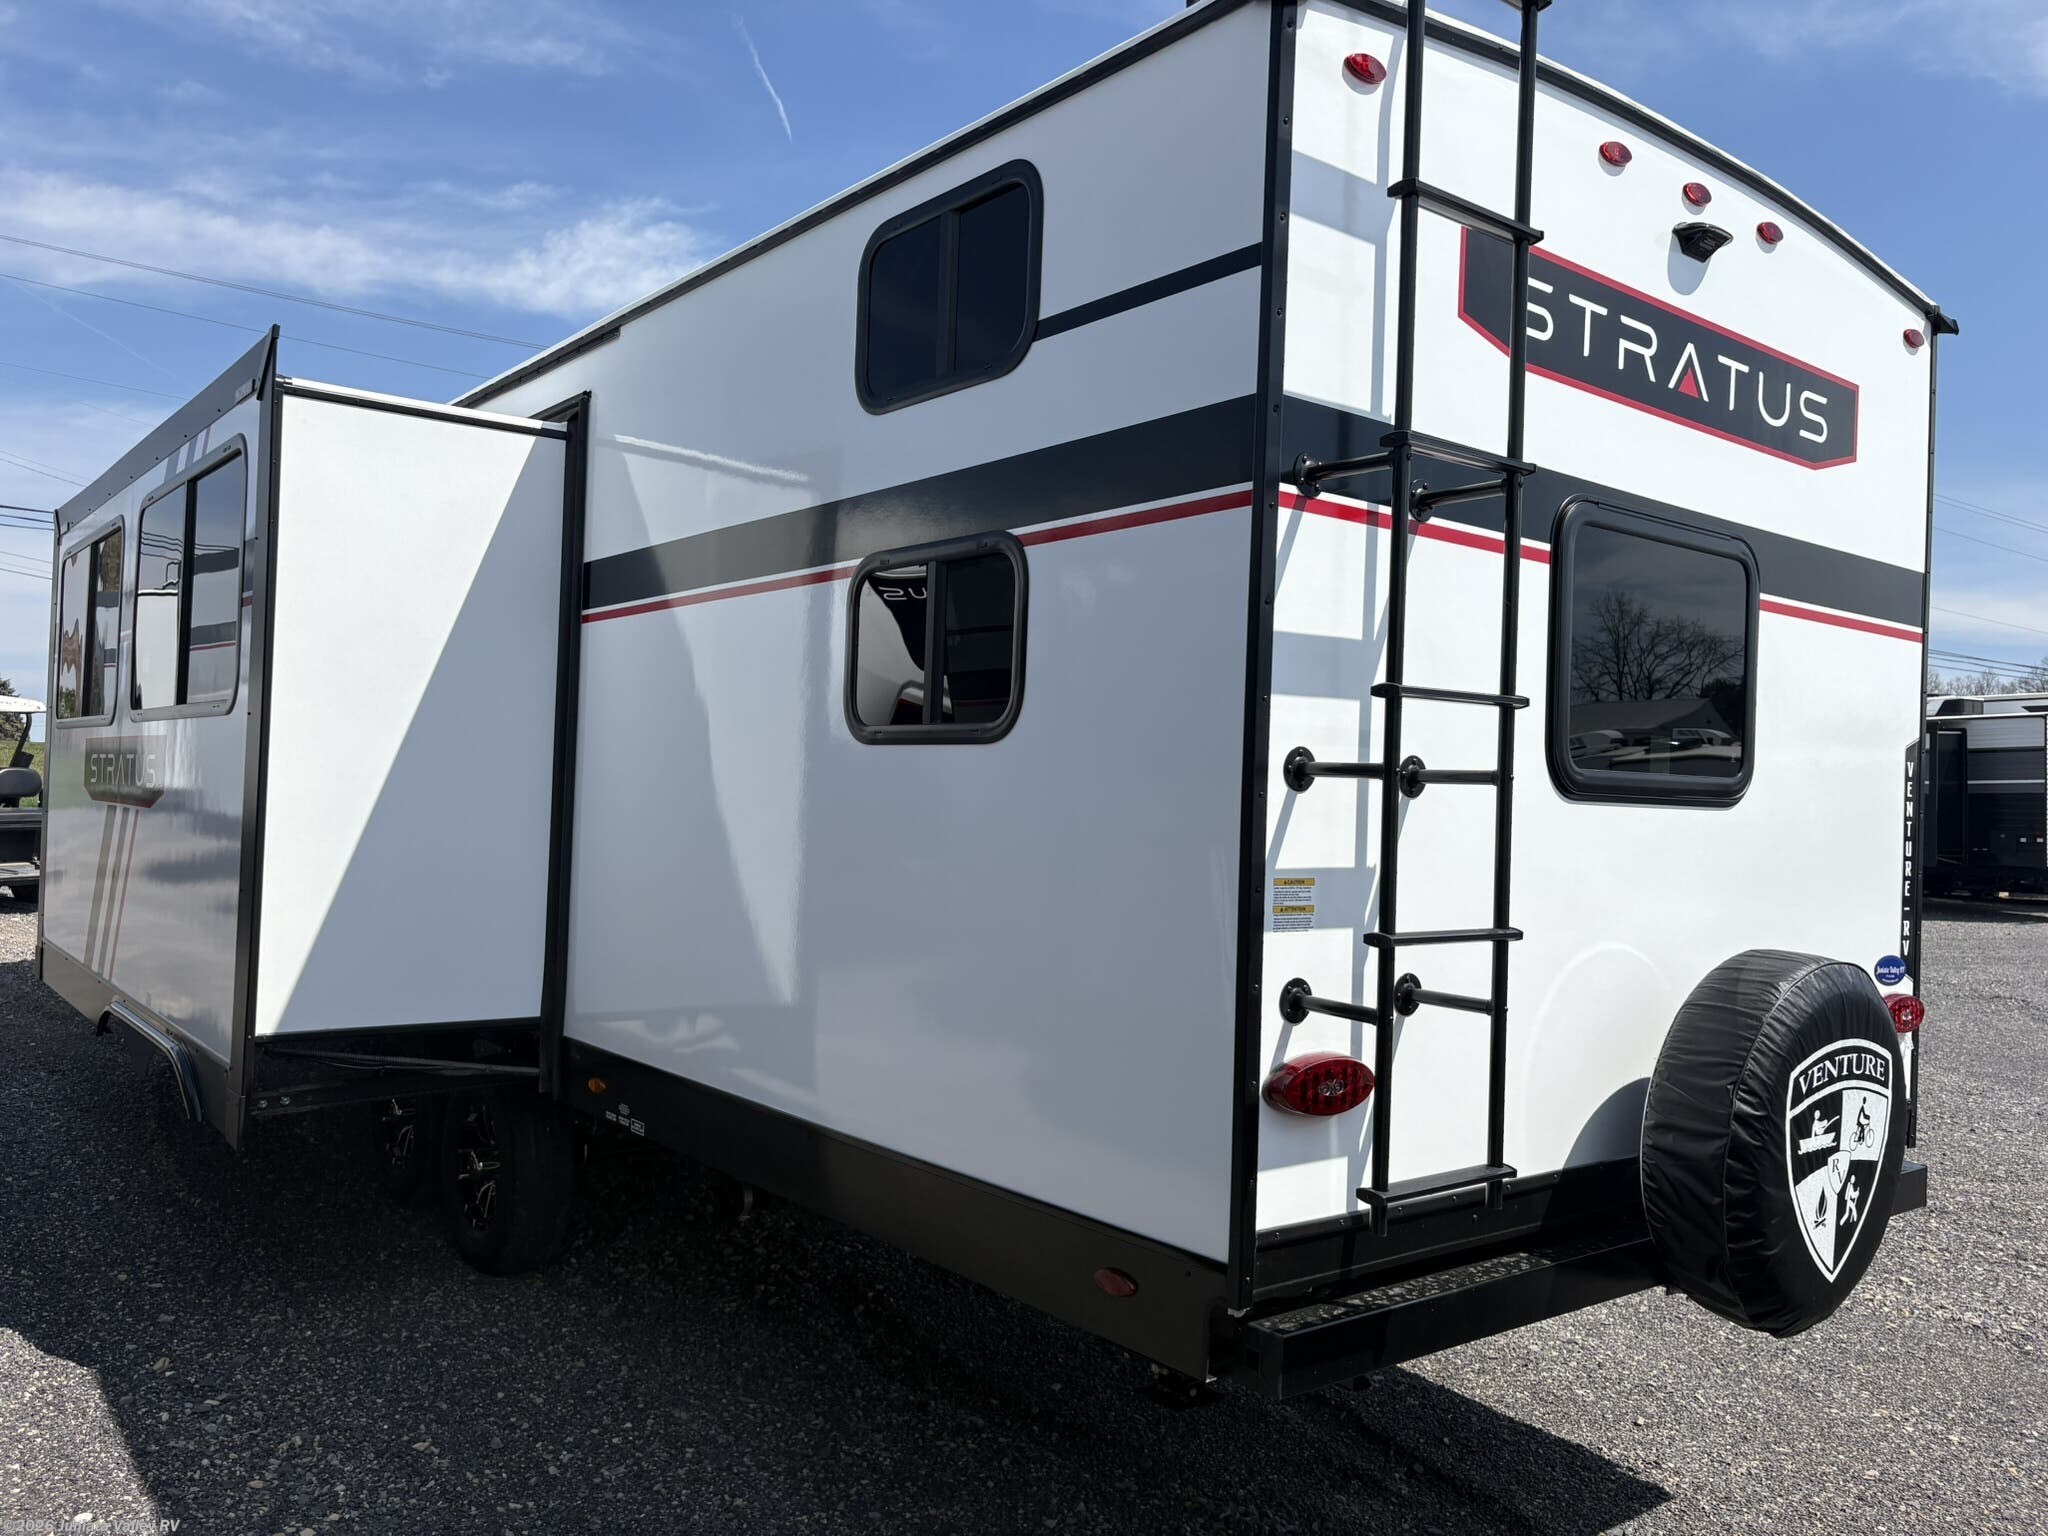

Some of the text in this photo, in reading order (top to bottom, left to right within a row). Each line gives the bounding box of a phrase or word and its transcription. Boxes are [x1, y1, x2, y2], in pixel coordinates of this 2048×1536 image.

[1526, 278, 1828, 444] STRATUS
[90, 753, 157, 788] STRATUS
[1798, 1053, 1886, 1095] VENTURE
